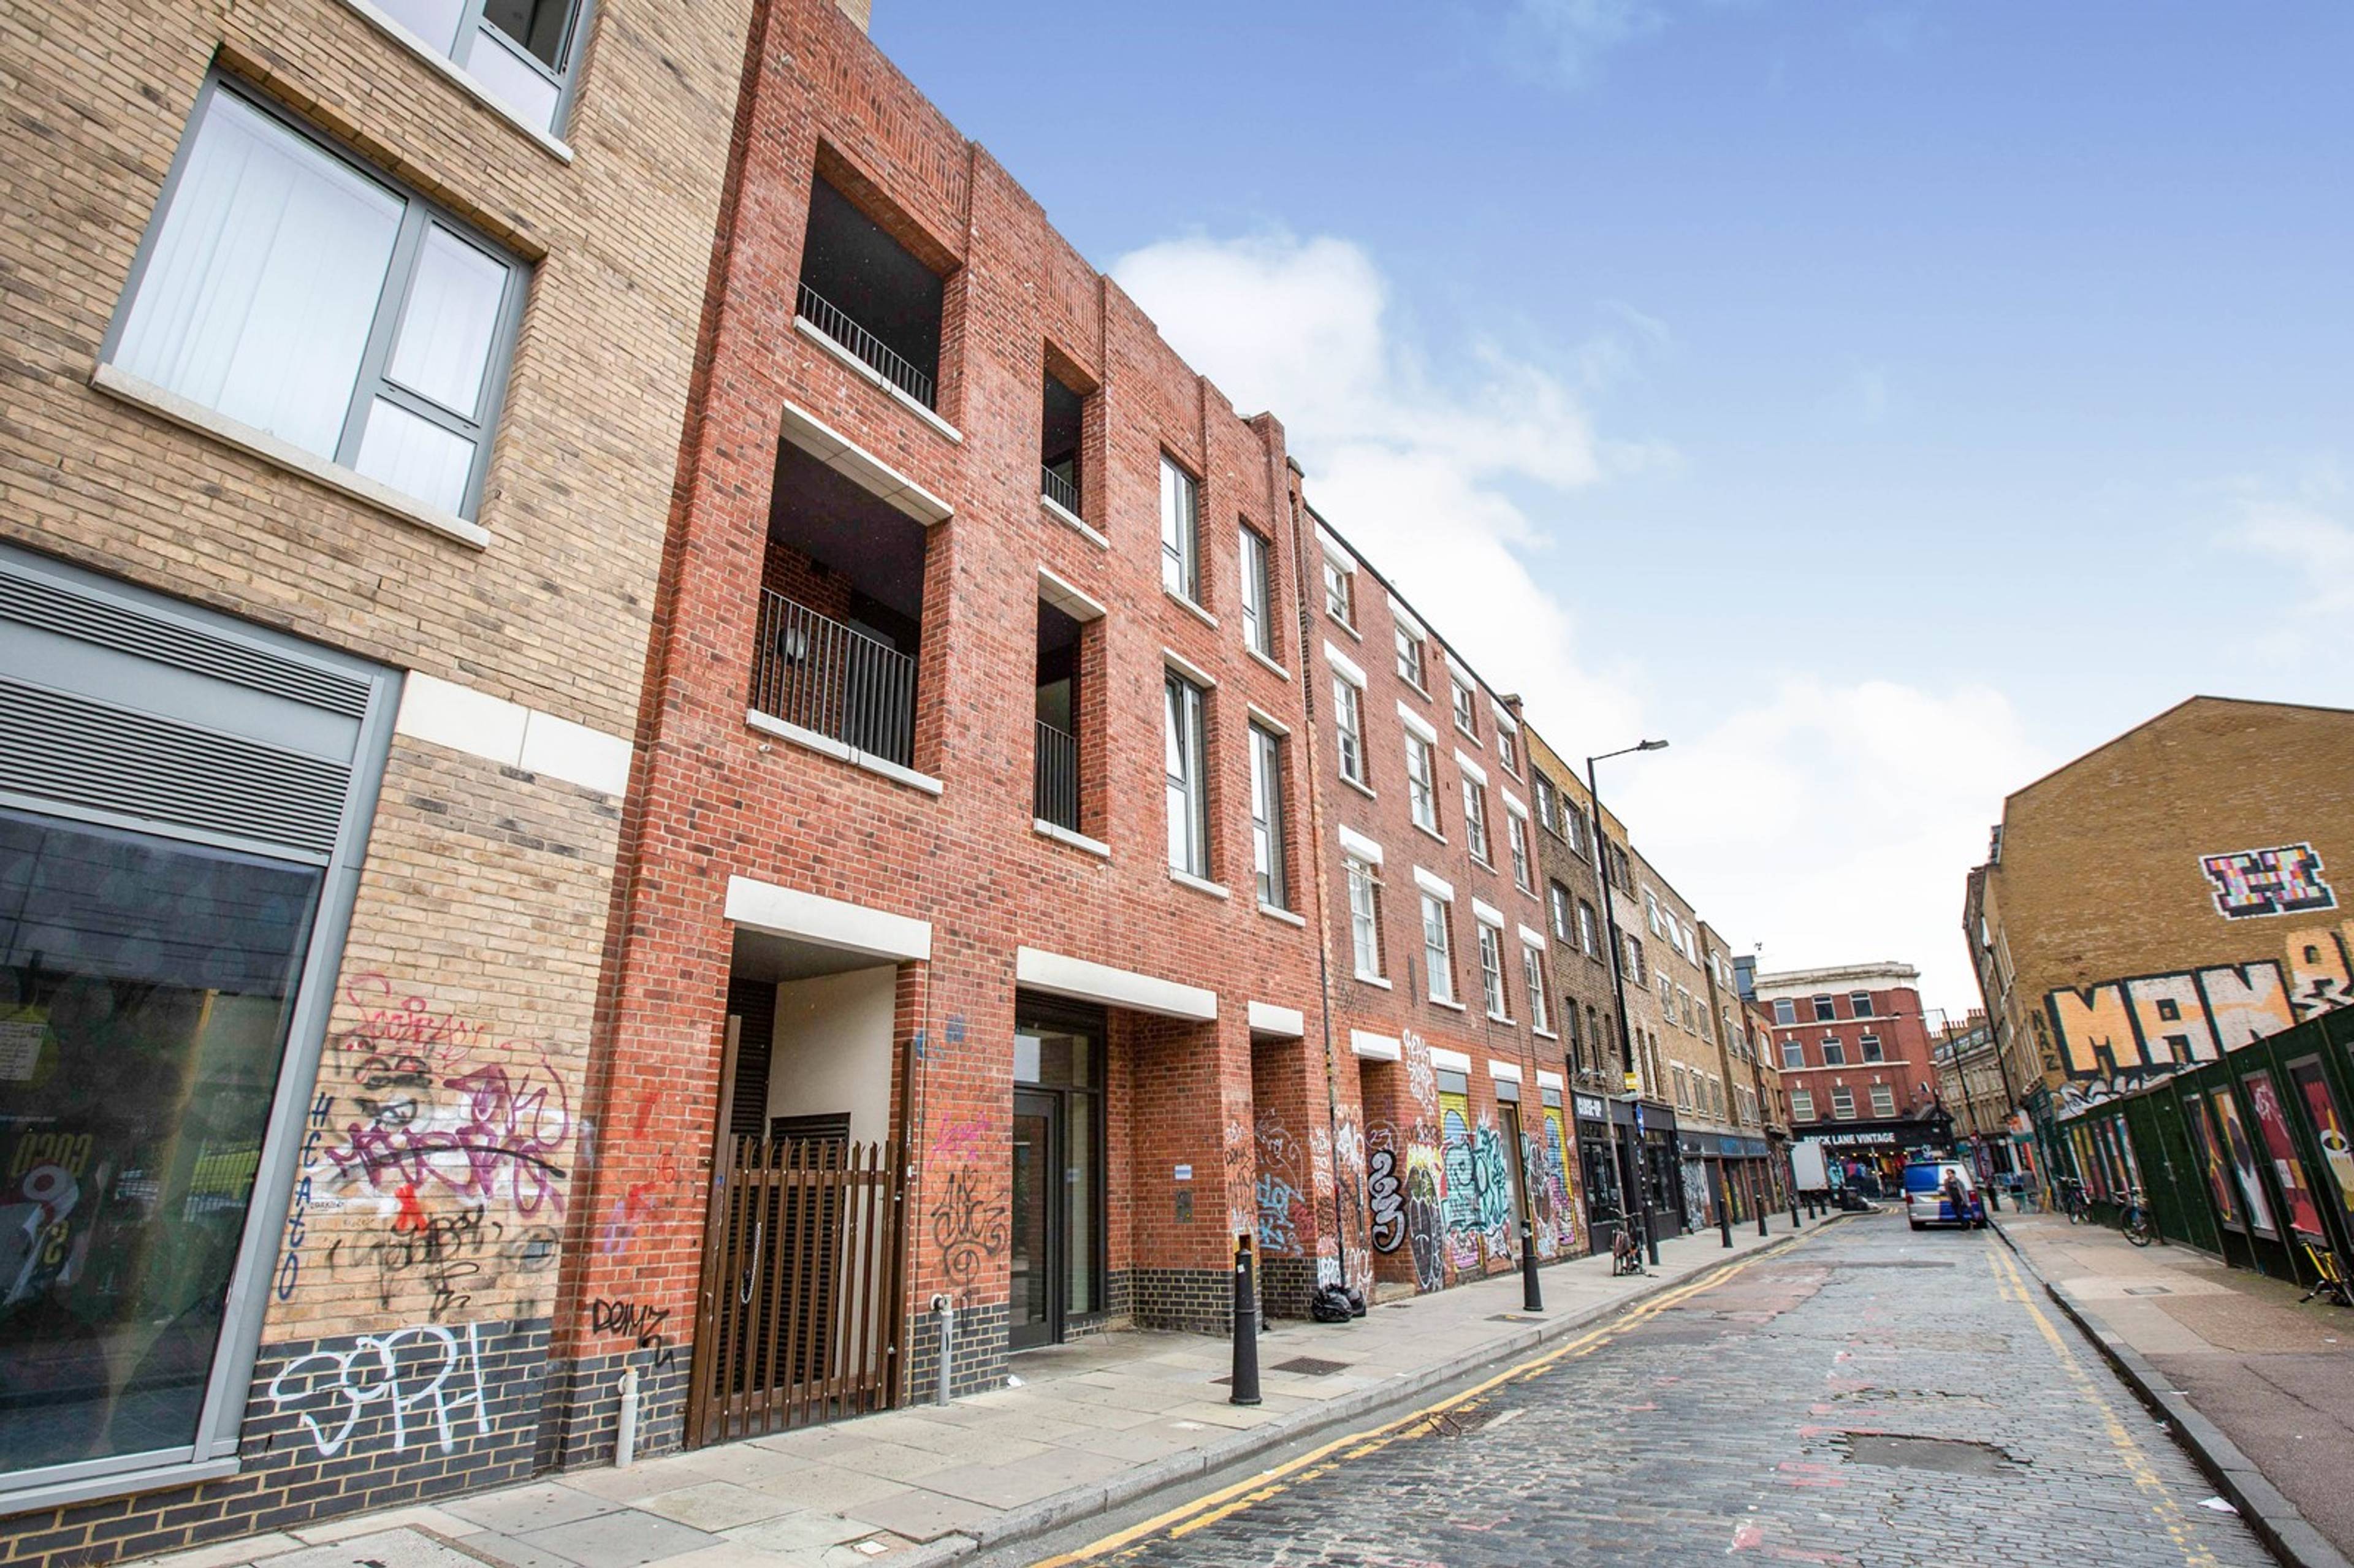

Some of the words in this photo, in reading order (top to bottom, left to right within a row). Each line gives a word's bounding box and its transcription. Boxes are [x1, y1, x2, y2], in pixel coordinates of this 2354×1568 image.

[1804, 1135, 1832, 1146] BRICK
[1832, 1134, 1856, 1145] LANE
[1856, 1132, 1896, 1144] VINTAGE
